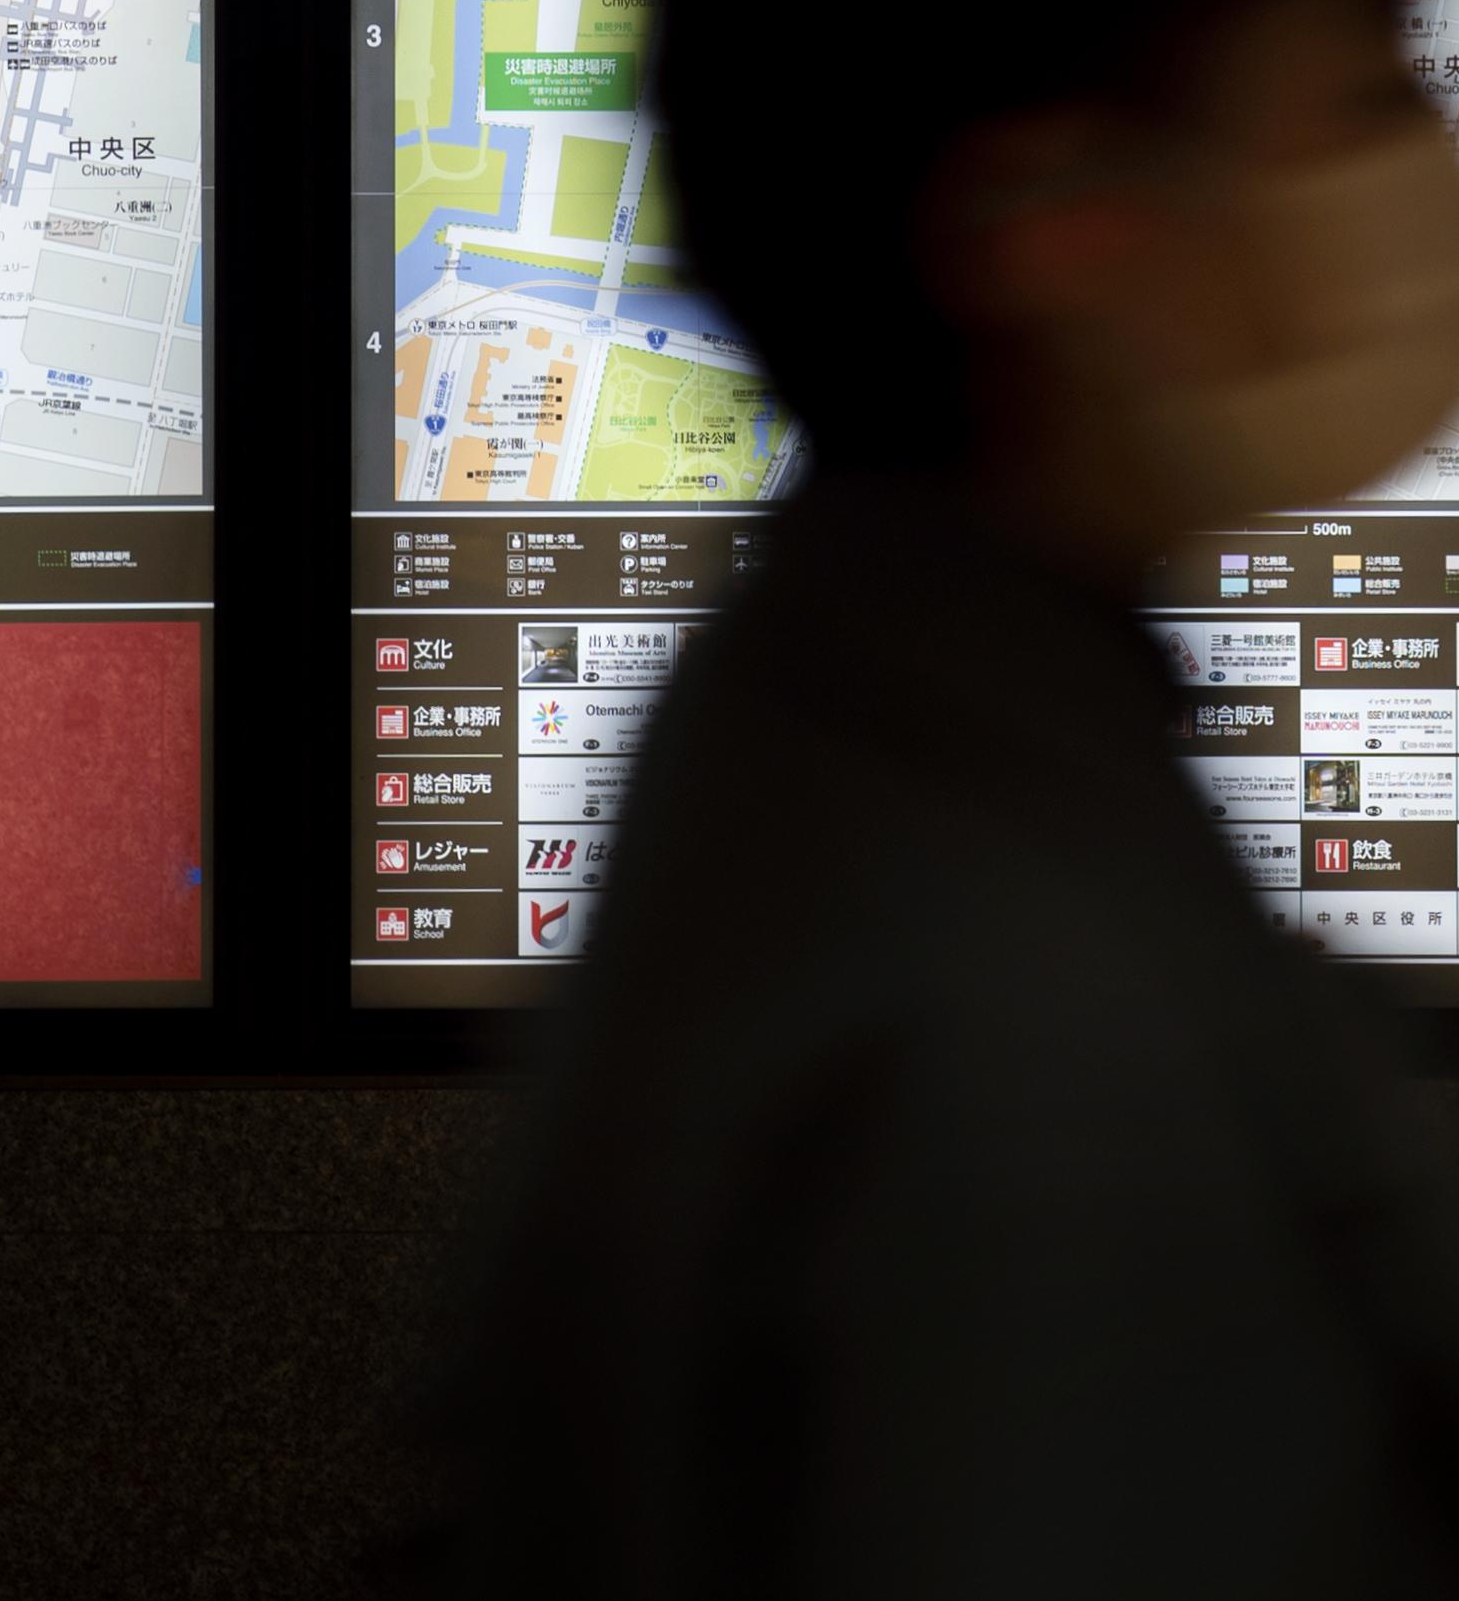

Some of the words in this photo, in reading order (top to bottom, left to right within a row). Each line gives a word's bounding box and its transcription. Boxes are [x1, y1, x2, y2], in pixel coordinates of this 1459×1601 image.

[366, 24, 382, 48] 3
[501, 57, 619, 76] 災害時退避場所
[68, 136, 156, 162] 中央区
[81, 163, 143, 180] Chuo-city
[365, 331, 382, 354] 4
[1312, 522, 1352, 536] 500m
[413, 638, 454, 660] 文化
[413, 773, 493, 794] 総合販売
[414, 841, 490, 862] レジャー
[1352, 839, 1393, 861] 飲食
[413, 907, 454, 929] 教育
[1316, 910, 1444, 927] 中央区役所
